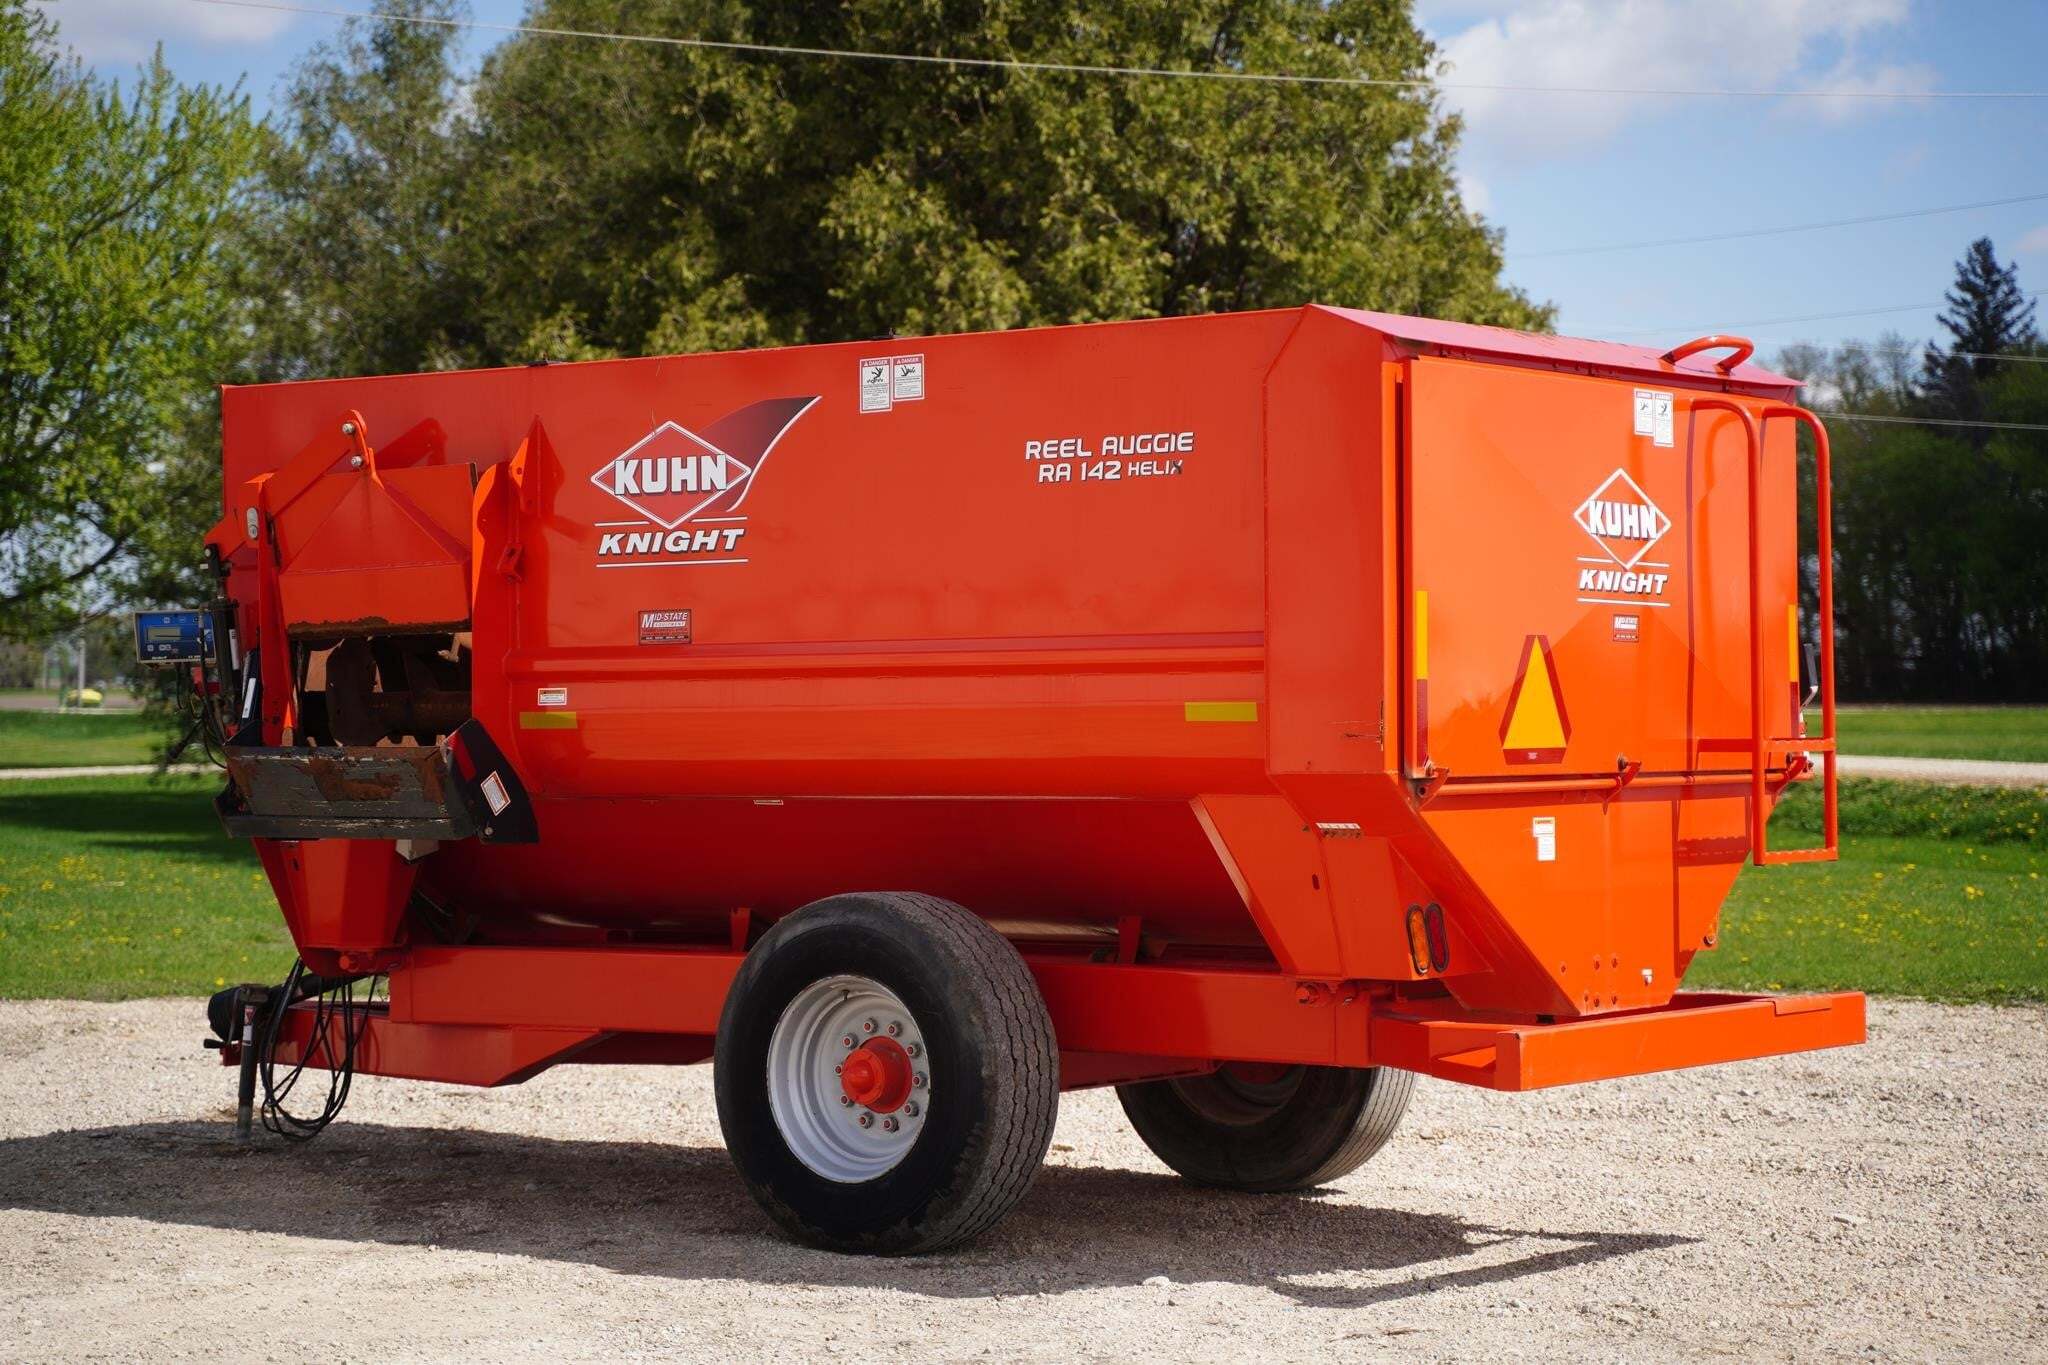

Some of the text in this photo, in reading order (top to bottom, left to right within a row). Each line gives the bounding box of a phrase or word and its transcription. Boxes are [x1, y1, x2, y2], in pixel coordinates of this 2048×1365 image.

[1025, 431, 1194, 460] REEL AUGGIE
[614, 454, 728, 496] KUHN
[1038, 459, 1183, 483] RA 142 HELIX
[1588, 499, 1659, 541] KUHN
[598, 528, 745, 555] KNIGHT
[1579, 568, 1668, 596] KNIGHT
